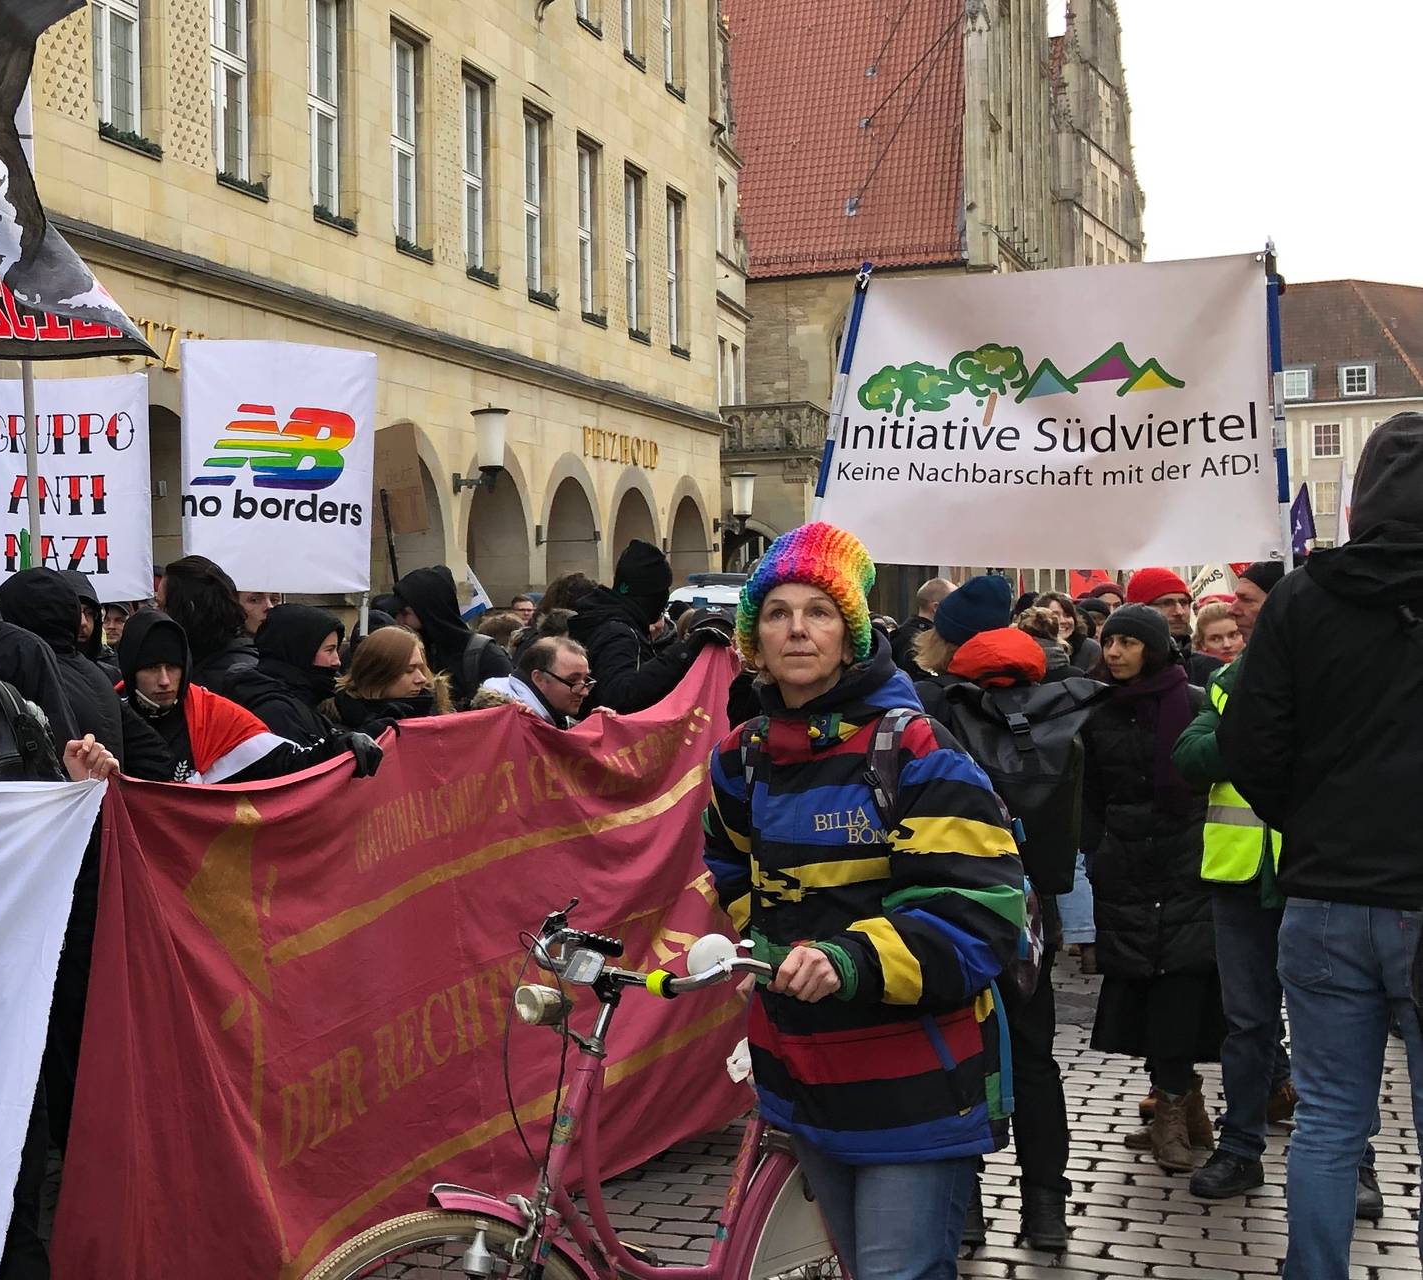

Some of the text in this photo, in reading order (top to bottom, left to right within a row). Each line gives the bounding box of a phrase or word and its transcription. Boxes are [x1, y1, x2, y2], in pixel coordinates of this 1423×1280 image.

[840, 401, 1258, 453] Initiative Südviertel
[837, 453, 1260, 486] Keine Nachbarschaft mit der AfD!
[7, 474, 107, 515] ANTI
[181, 489, 362, 527] no borders
[277, 1045, 368, 1169] DER
